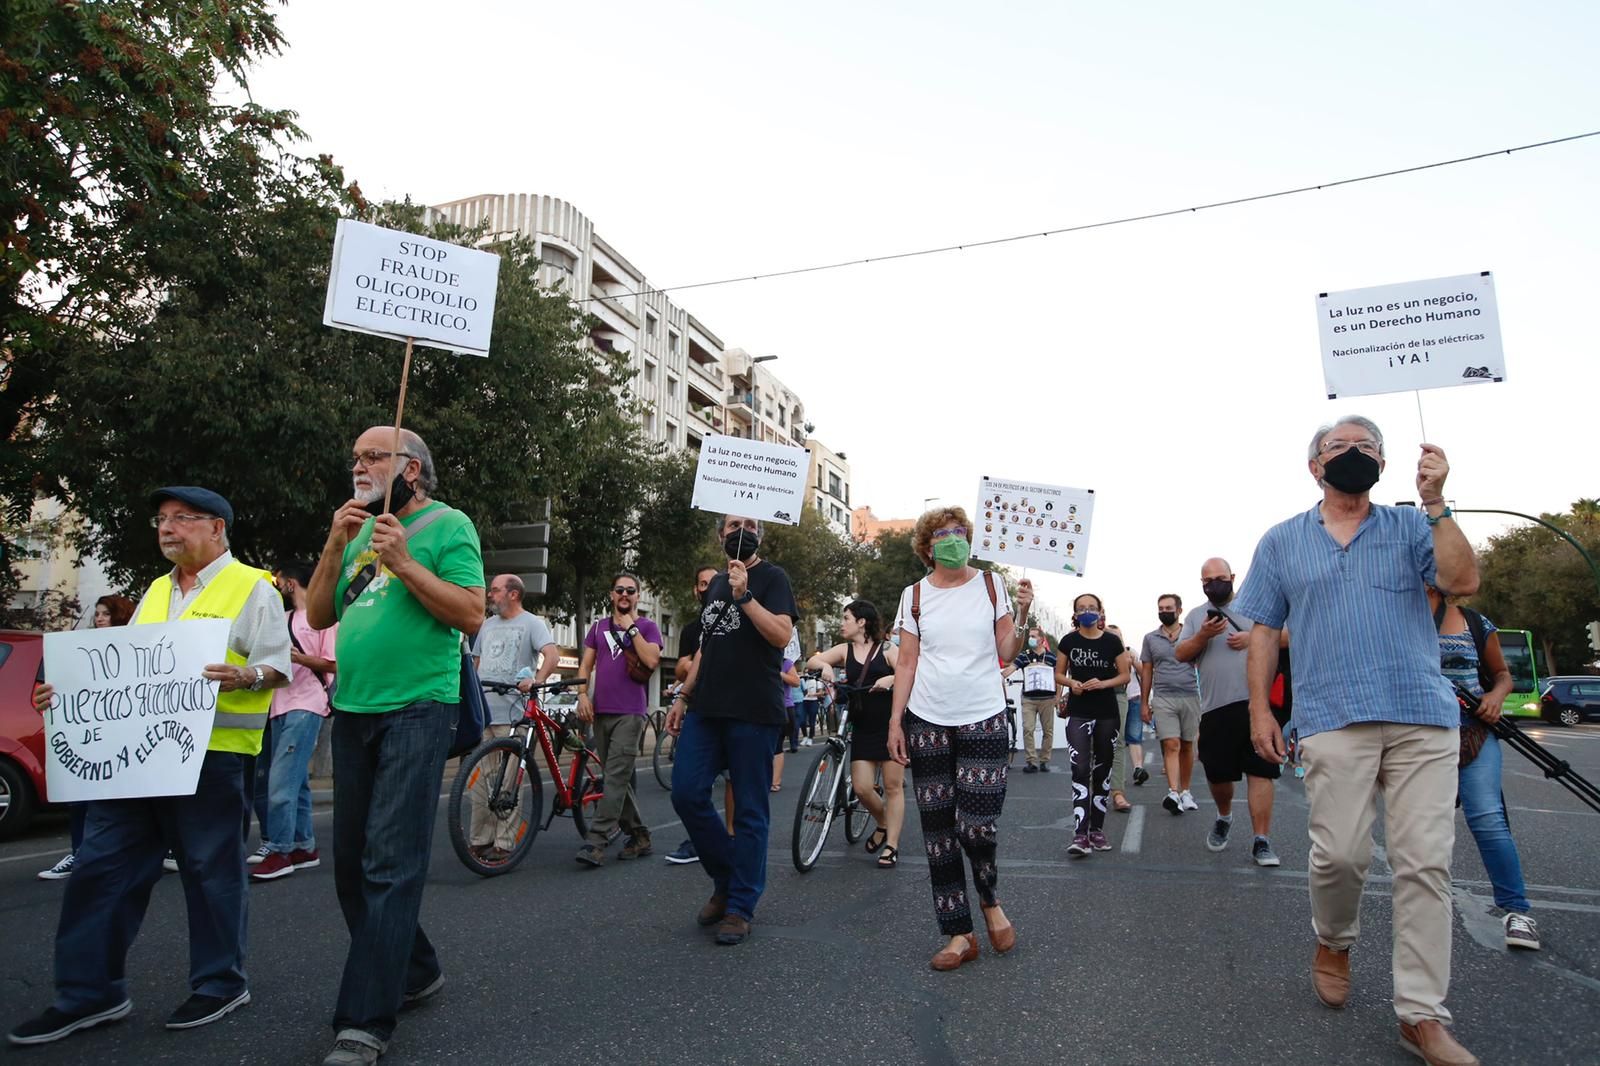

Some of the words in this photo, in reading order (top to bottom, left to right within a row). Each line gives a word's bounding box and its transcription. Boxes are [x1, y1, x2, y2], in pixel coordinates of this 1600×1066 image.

[399, 241, 447, 263] STOP
[380, 258, 460, 287] FRAUDE
[356, 275, 477, 311] OLIGOPOLIO
[356, 296, 471, 332] ELÉCTRICO.
[1329, 308, 1343, 318] La
[1346, 306, 1363, 316] luz
[1367, 305, 1383, 314] no
[1386, 303, 1400, 311] es
[1403, 300, 1420, 309] un
[1423, 292, 1478, 307] negocio,
[1333, 325, 1347, 333] es
[1351, 322, 1366, 331] un
[1369, 316, 1422, 329] Derecho
[1426, 308, 1481, 322] Humano
[1332, 342, 1405, 357] Nacionalización
[1408, 339, 1420, 348] de
[1422, 338, 1436, 346] las
[1438, 332, 1485, 344] eléctricas
[718, 448, 730, 456] luz
[766, 456, 798, 467] negocio,
[730, 460, 762, 472] Derecho
[764, 467, 797, 478] Humano
[702, 474, 747, 487] Nacionalización
[767, 485, 794, 495] eléctricas
[1070, 648, 1099, 662] Chic
[80, 727, 102, 745] DE
